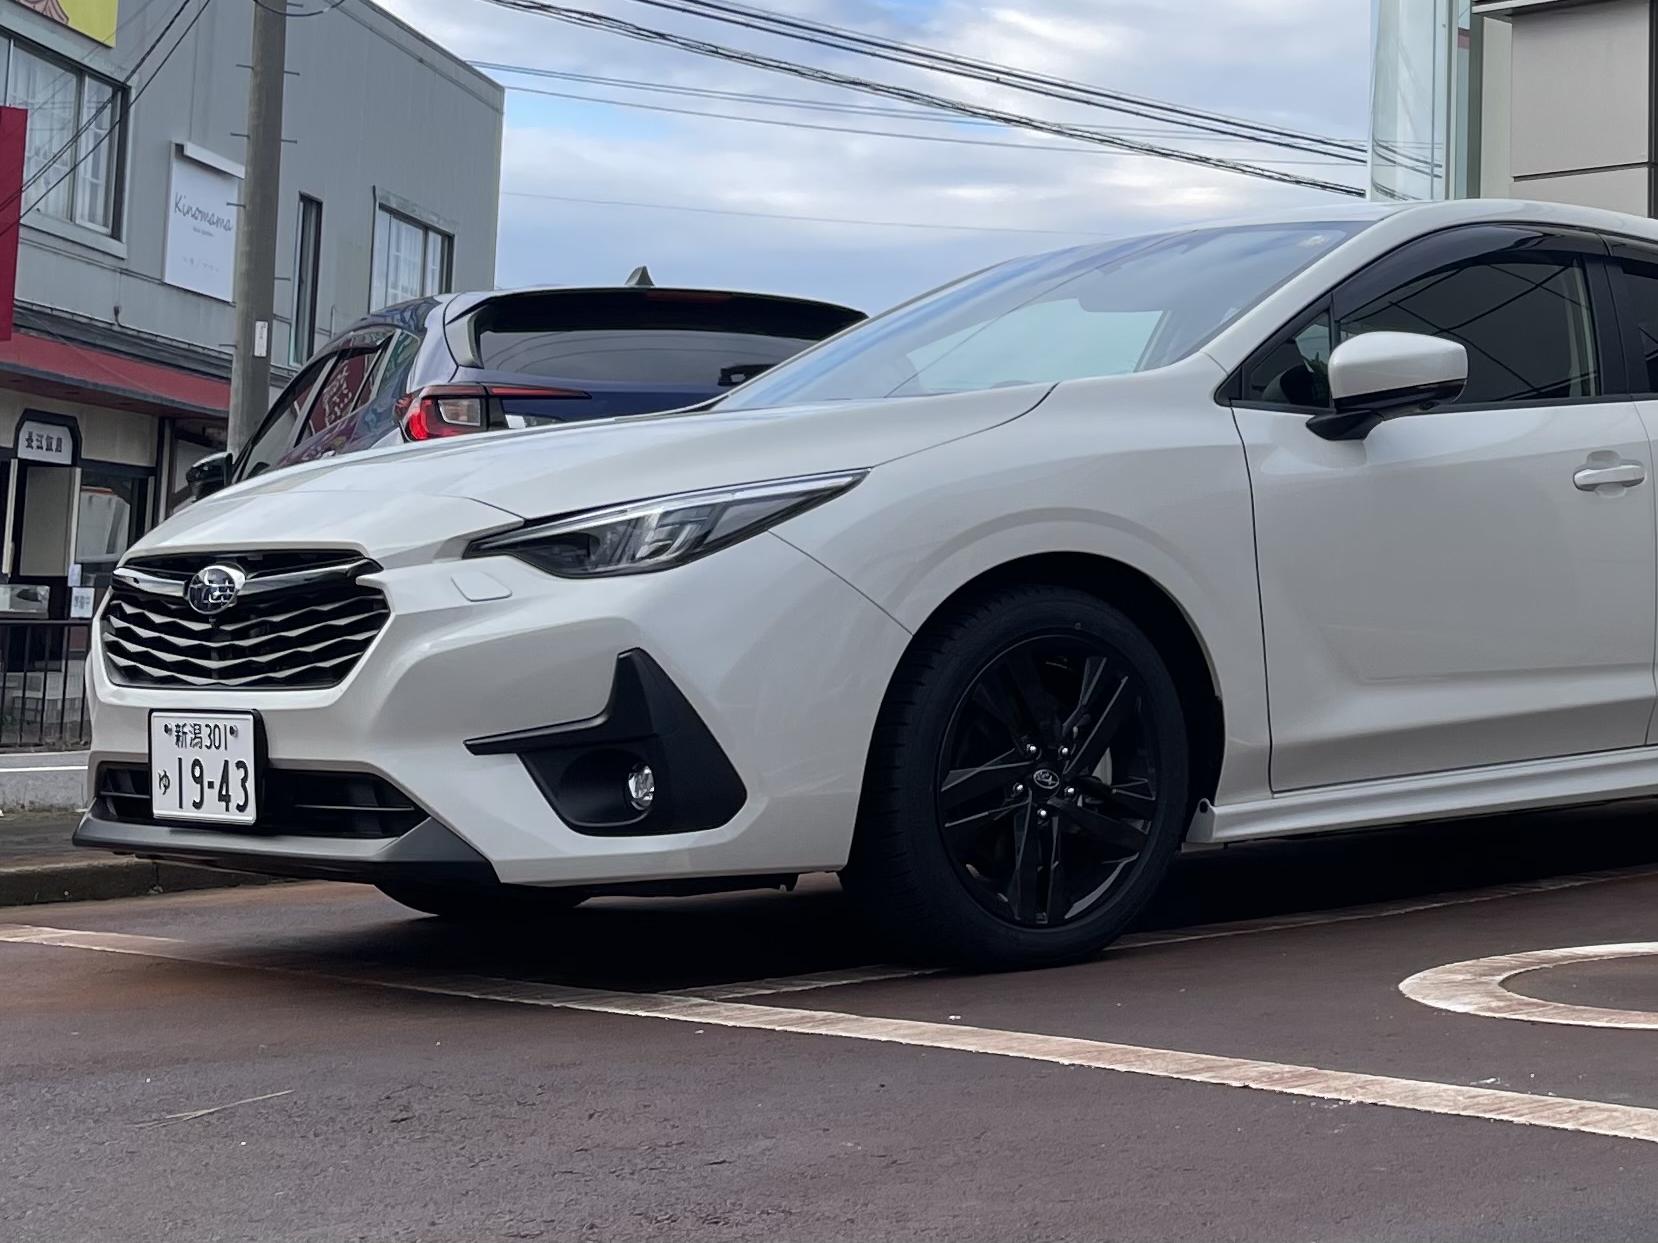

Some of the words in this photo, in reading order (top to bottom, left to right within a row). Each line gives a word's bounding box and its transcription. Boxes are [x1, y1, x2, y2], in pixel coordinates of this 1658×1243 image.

[174, 192, 234, 232] Kinomama
[157, 769, 171, 796] ゆ
[177, 757, 249, 813] 19-43
